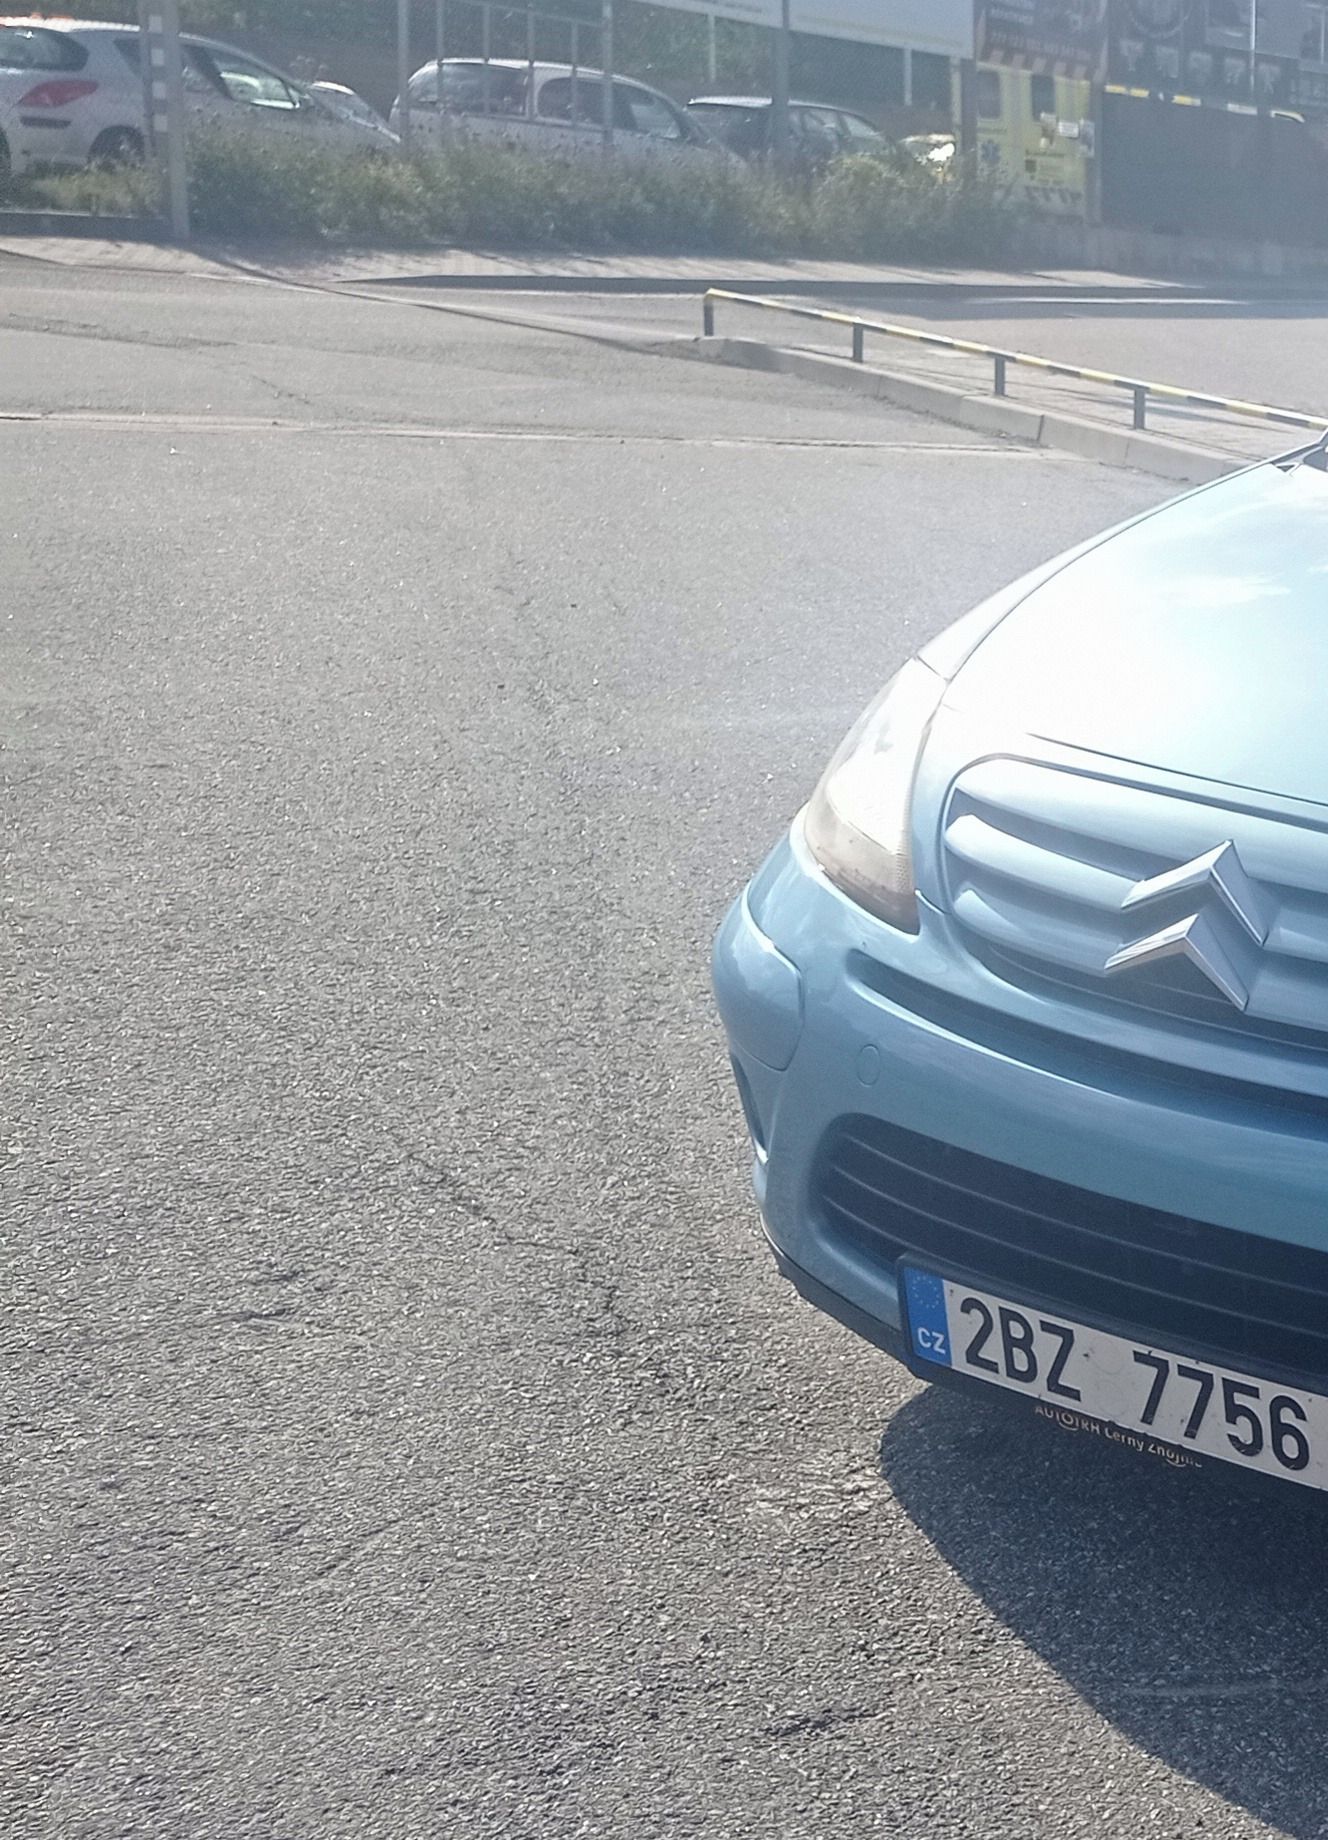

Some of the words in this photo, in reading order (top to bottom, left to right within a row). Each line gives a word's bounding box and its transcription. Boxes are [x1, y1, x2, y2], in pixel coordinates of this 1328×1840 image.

[917, 1326, 946, 1355] CZ
[960, 1297, 1081, 1402] 2BZ
[1133, 1349, 1310, 1471] 7756
